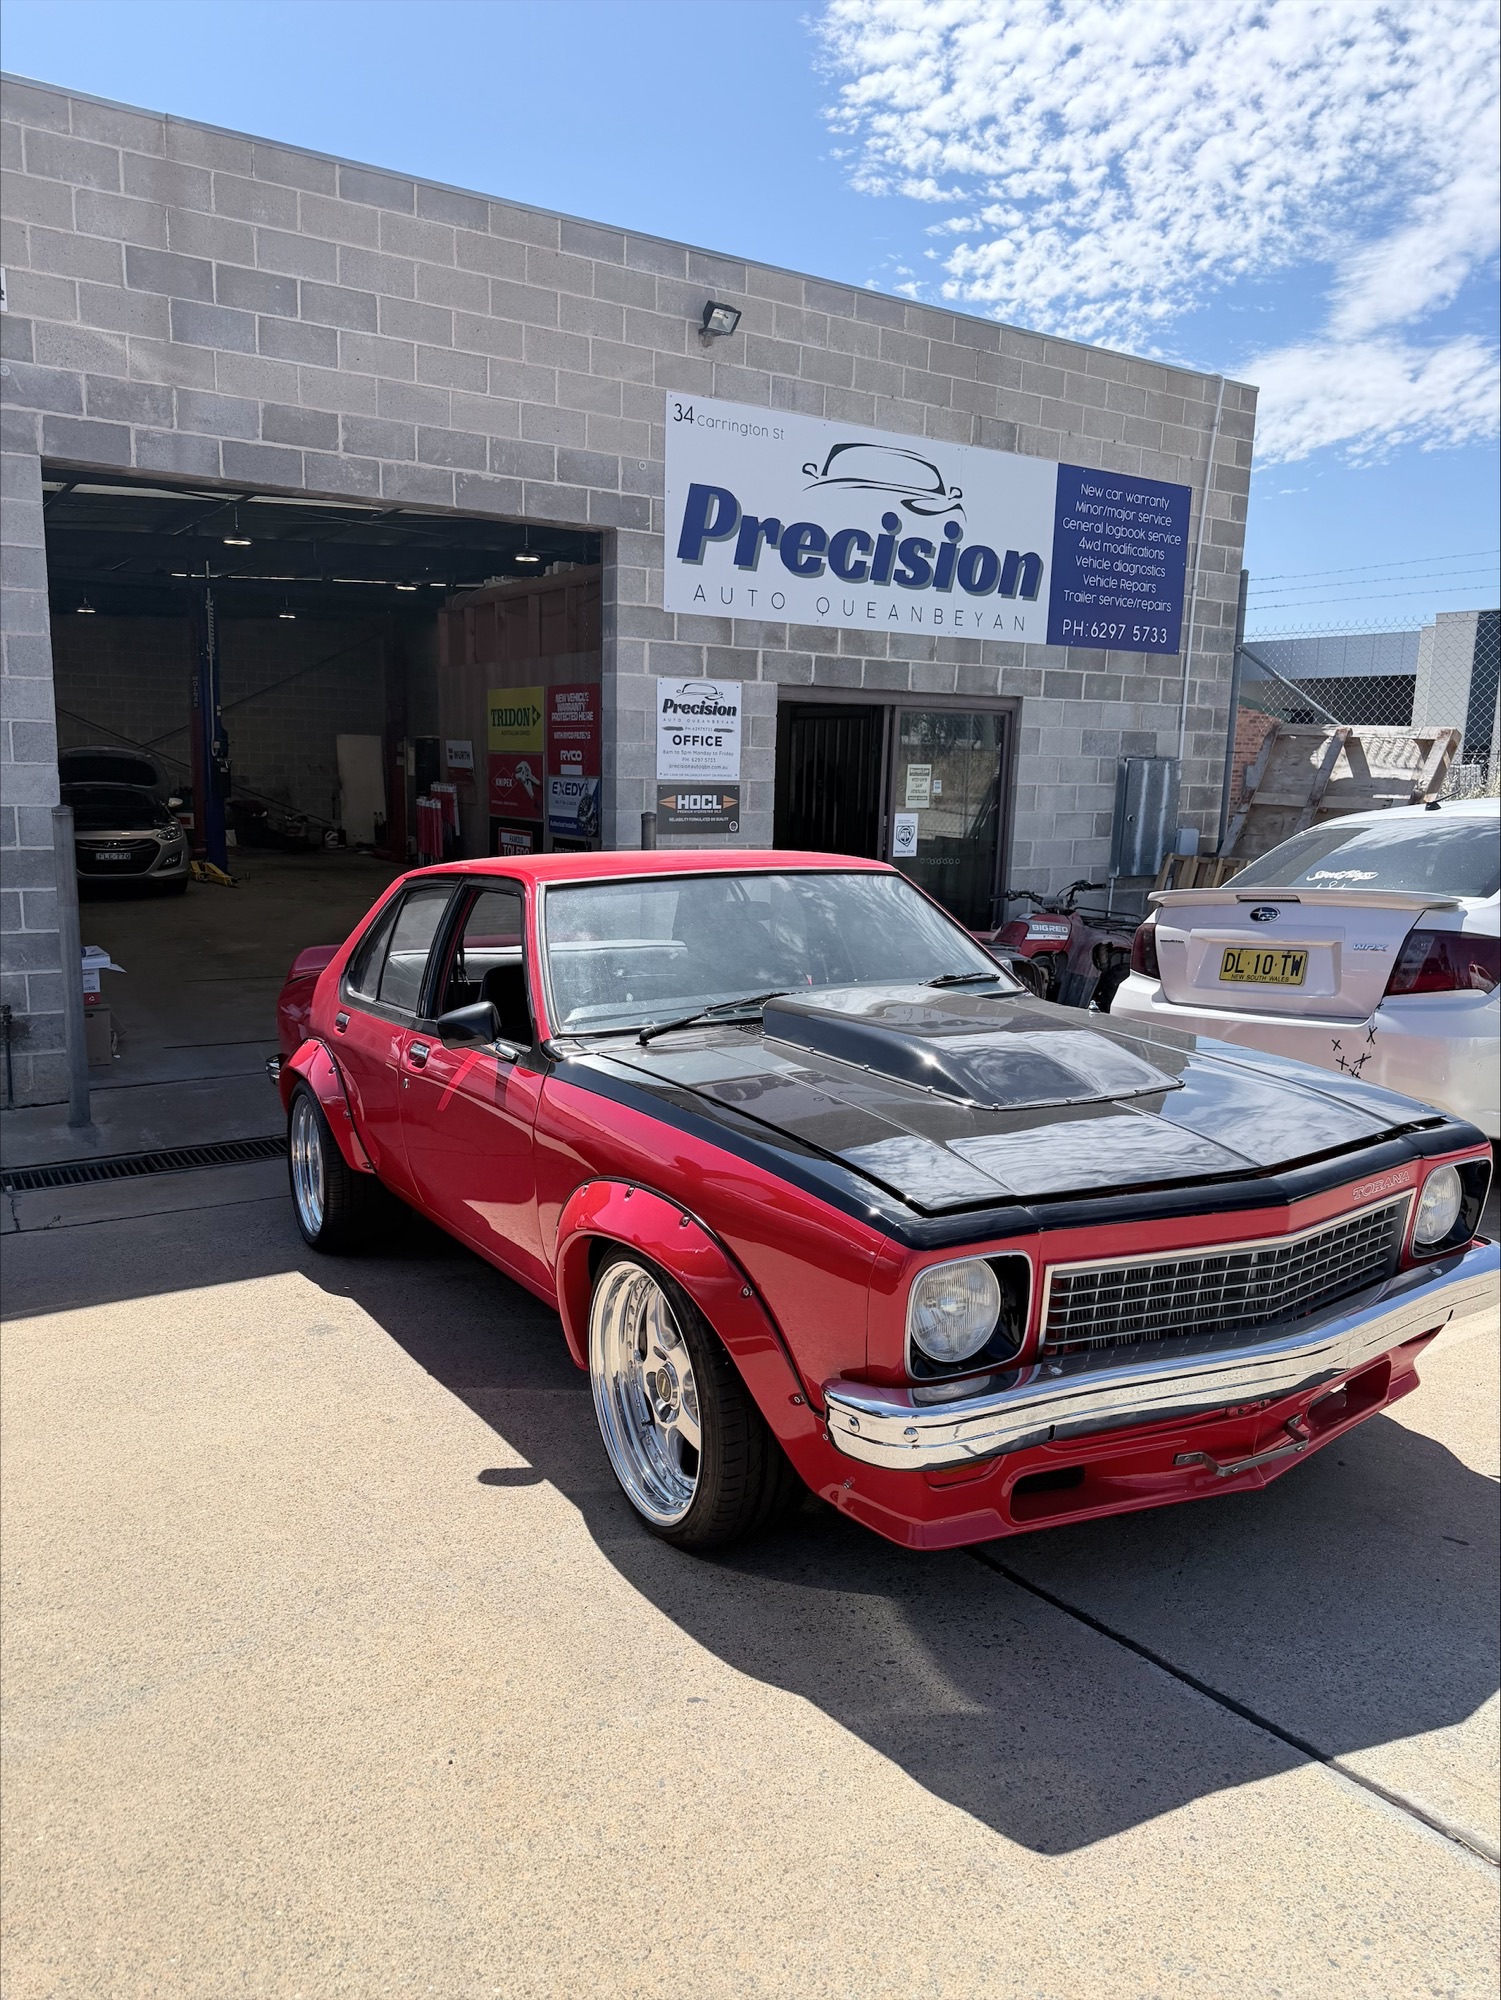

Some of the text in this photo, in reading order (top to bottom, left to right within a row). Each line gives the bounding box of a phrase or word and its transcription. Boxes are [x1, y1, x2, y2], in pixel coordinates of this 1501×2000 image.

[673, 402, 784, 441] 34 Carrington St
[1080, 483, 1170, 511] New car warranty
[1075, 500, 1172, 527] Minor/major service
[1062, 516, 1182, 546] General logbook service
[676, 482, 1044, 602] Precision
[1078, 536, 1165, 560] 4wd modifications
[1075, 555, 1166, 578] Vehicle diagnostics
[1082, 574, 1157, 594] Vehicle Repairs
[693, 584, 1026, 632] AUTO QUEANBEYAN
[1063, 589, 1172, 612] Trailer service/repairs
[1132, 625, 1167, 644] 5733
[490, 707, 531, 727] TRIDON
[551, 711, 594, 722] PROTECTED HERE
[556, 702, 586, 712] WARRANTY
[662, 698, 737, 717] Precision
[672, 734, 723, 747] OFFICE
[560, 749, 583, 762] RYCO
[495, 777, 513, 787] KNIPEX
[552, 781, 586, 797] EXEDY
[677, 794, 722, 810] HOCL
[1353, 943, 1389, 952] WRX
